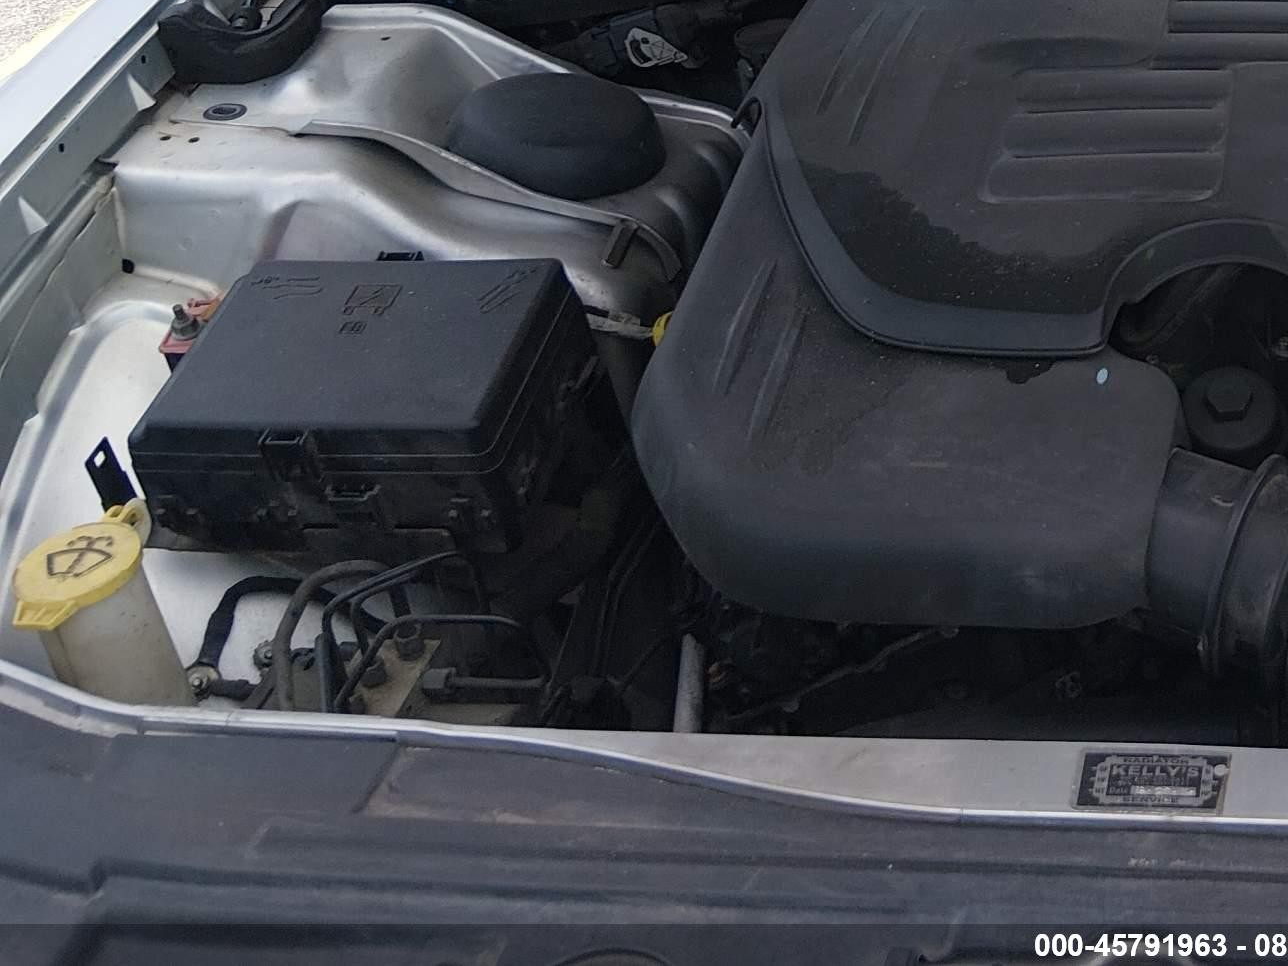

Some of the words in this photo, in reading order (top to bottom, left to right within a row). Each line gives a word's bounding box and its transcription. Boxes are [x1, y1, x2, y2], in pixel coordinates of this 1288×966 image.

[1123, 757, 1189, 765] RADIATOR
[1111, 764, 1200, 777] KELLY'S
[1122, 795, 1179, 803] SERVICE
